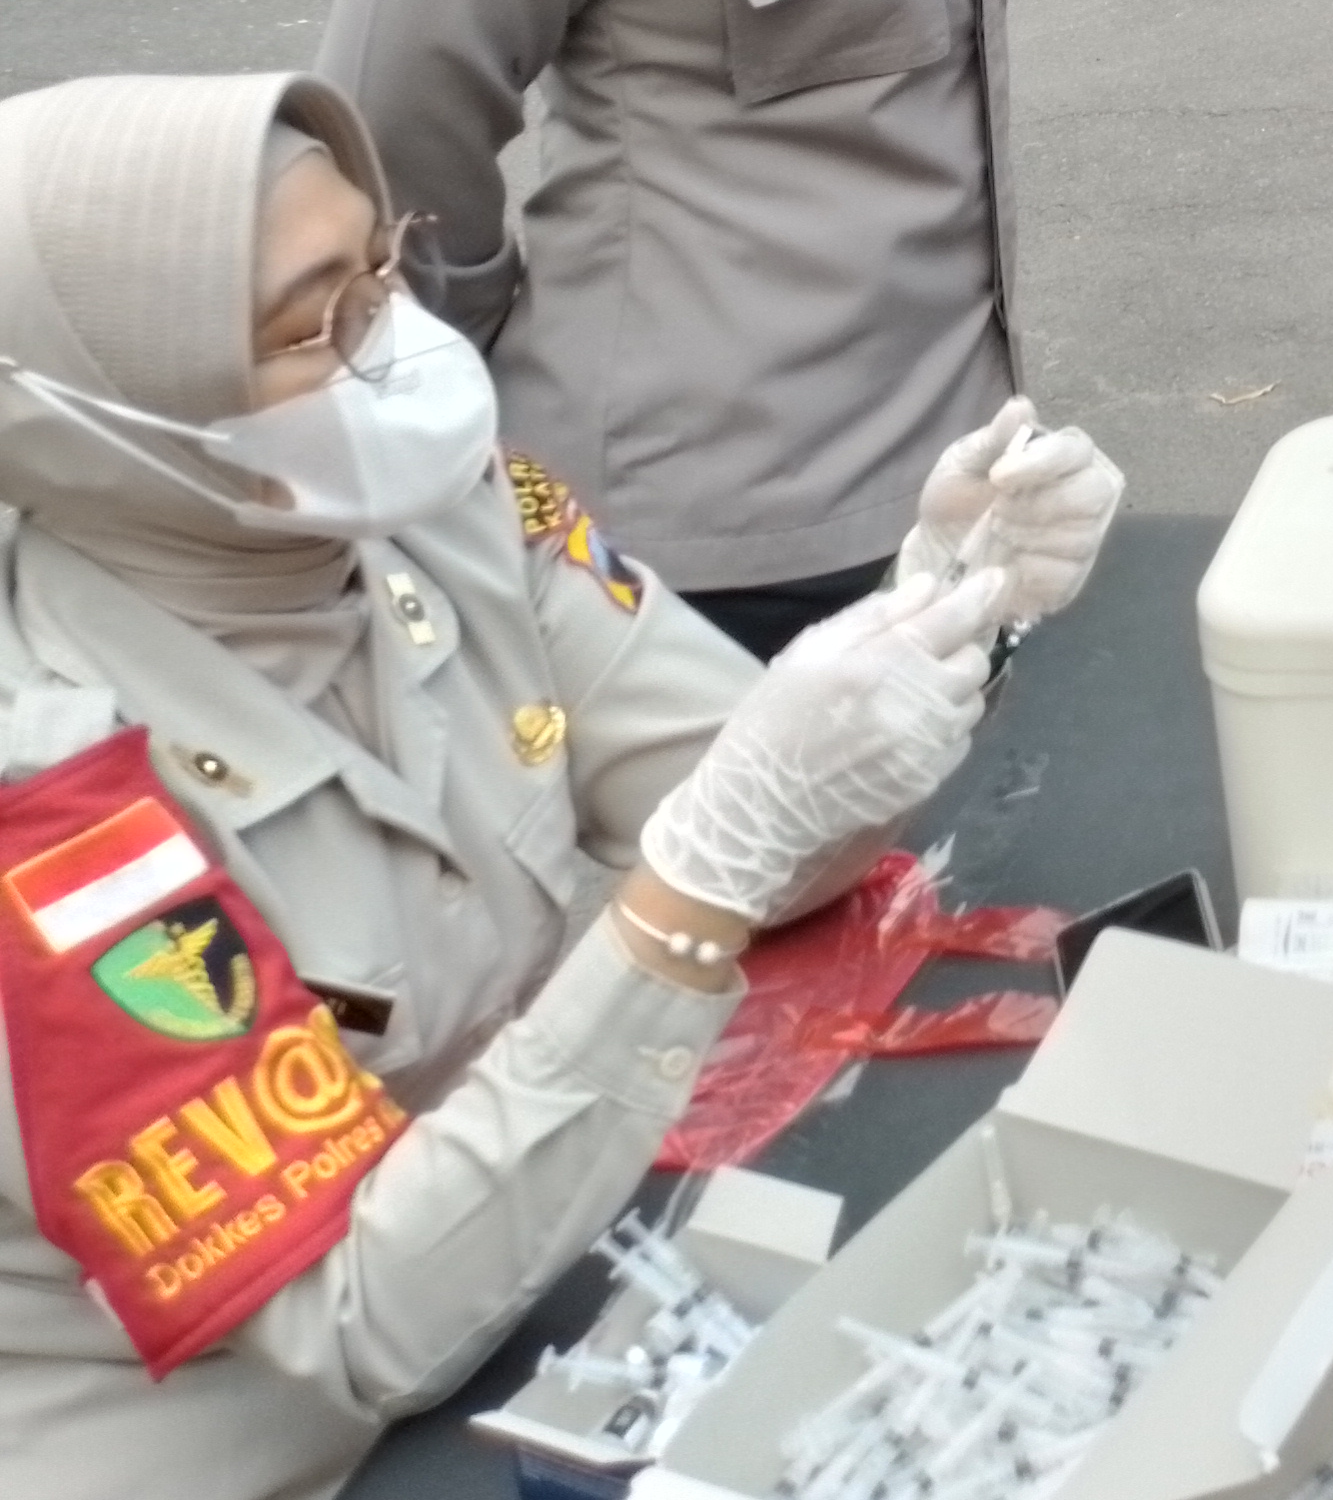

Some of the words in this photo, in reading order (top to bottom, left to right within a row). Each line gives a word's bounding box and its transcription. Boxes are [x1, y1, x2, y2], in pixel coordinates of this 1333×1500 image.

[75, 1003, 385, 1257] REV@
[146, 1186, 287, 1299] Dokkes
[286, 1115, 385, 1200] Polres
